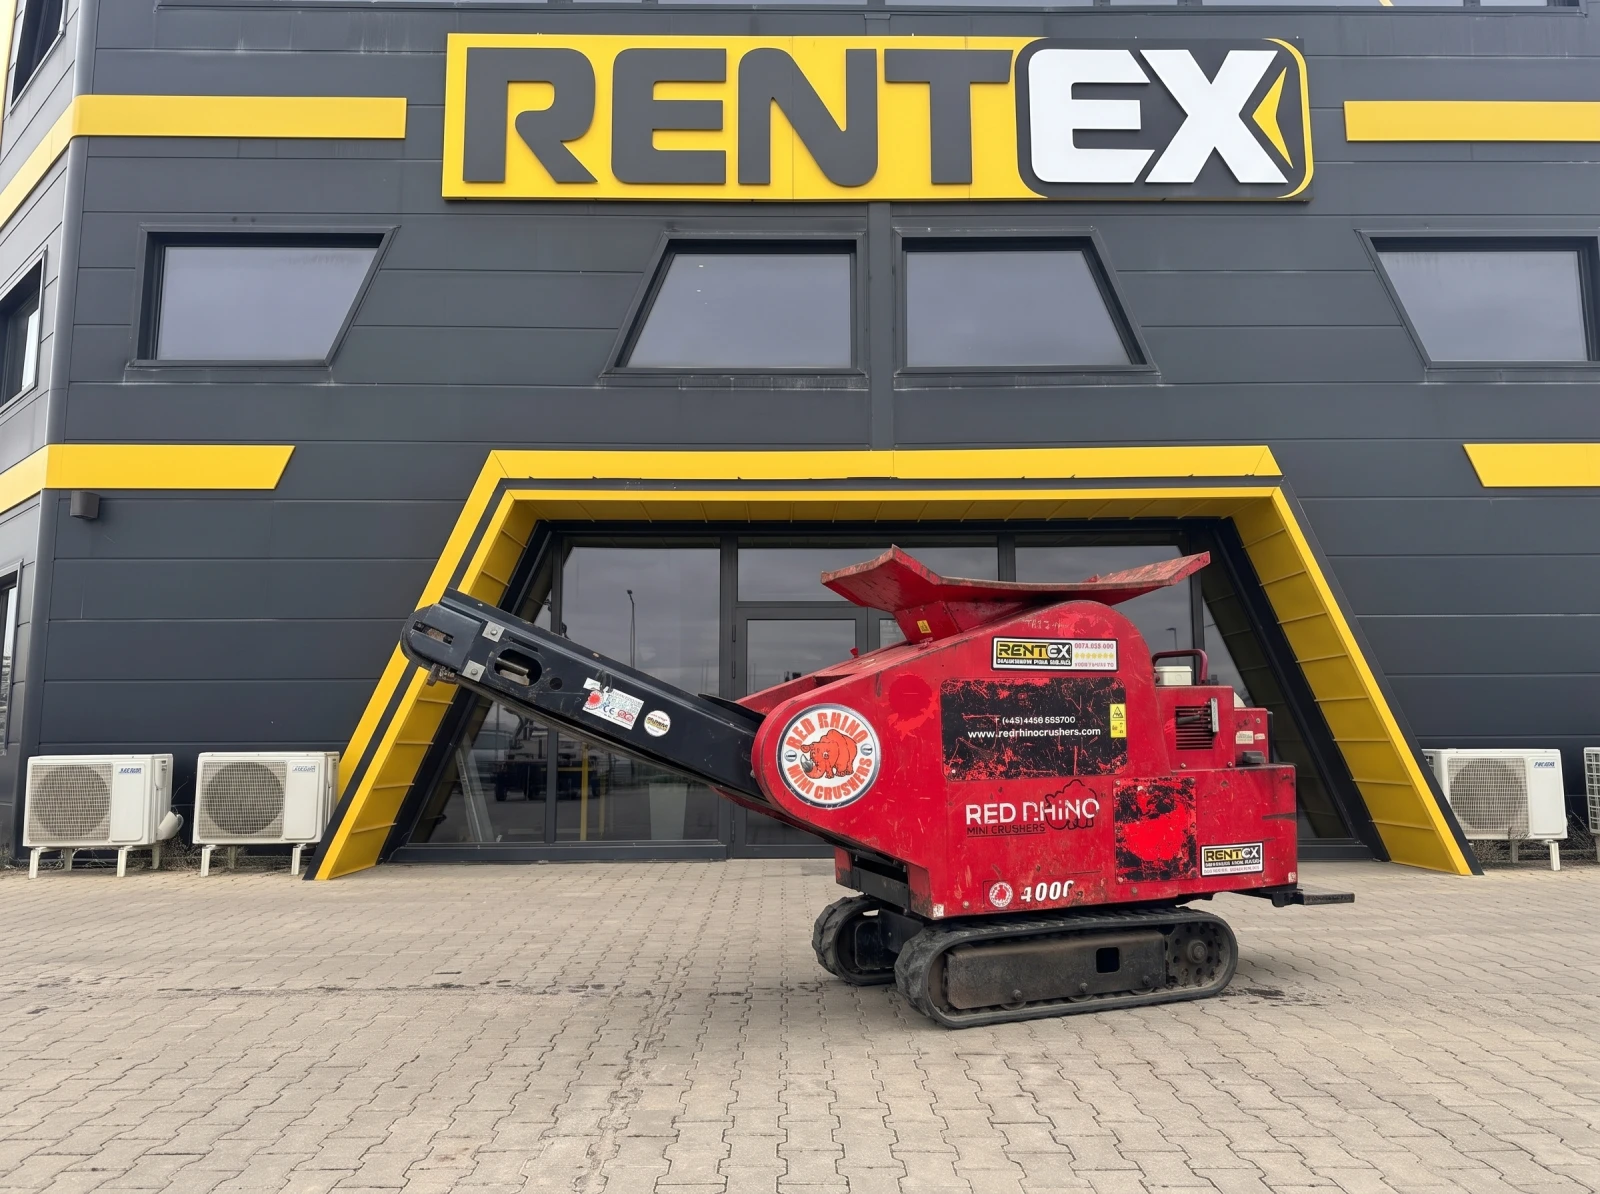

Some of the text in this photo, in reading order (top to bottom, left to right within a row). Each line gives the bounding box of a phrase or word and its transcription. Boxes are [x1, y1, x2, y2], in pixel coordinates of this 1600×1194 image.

[463, 47, 1289, 187] RENTEX
[998, 643, 1070, 659] RENTEX
[786, 712, 868, 750] RED RHINO
[967, 727, 1101, 738] www.redrhinocrushers.com
[787, 758, 872, 800] MINI CRUSHERS
[965, 802, 1016, 825] RED
[966, 823, 1046, 836] MINI CRUSHERS
